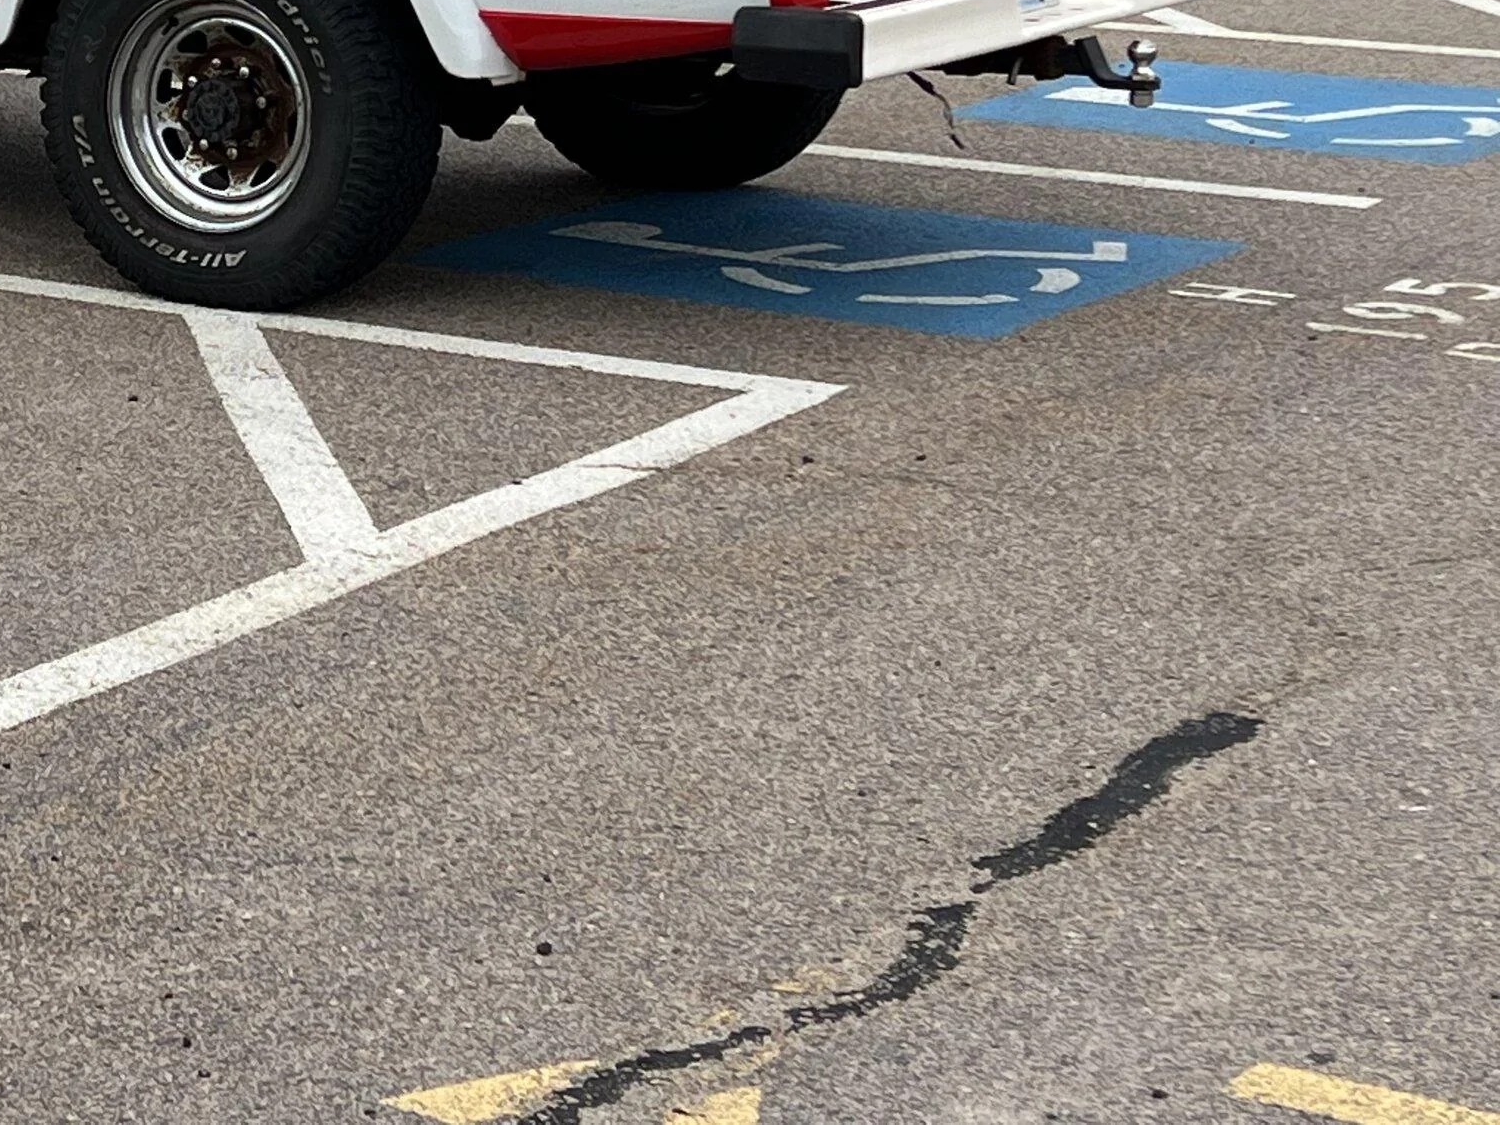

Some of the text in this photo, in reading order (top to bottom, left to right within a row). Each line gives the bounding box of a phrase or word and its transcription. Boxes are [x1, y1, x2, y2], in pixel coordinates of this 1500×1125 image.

[72, 114, 248, 268] All-Terrain T/A
[1167, 281, 1297, 307] H
